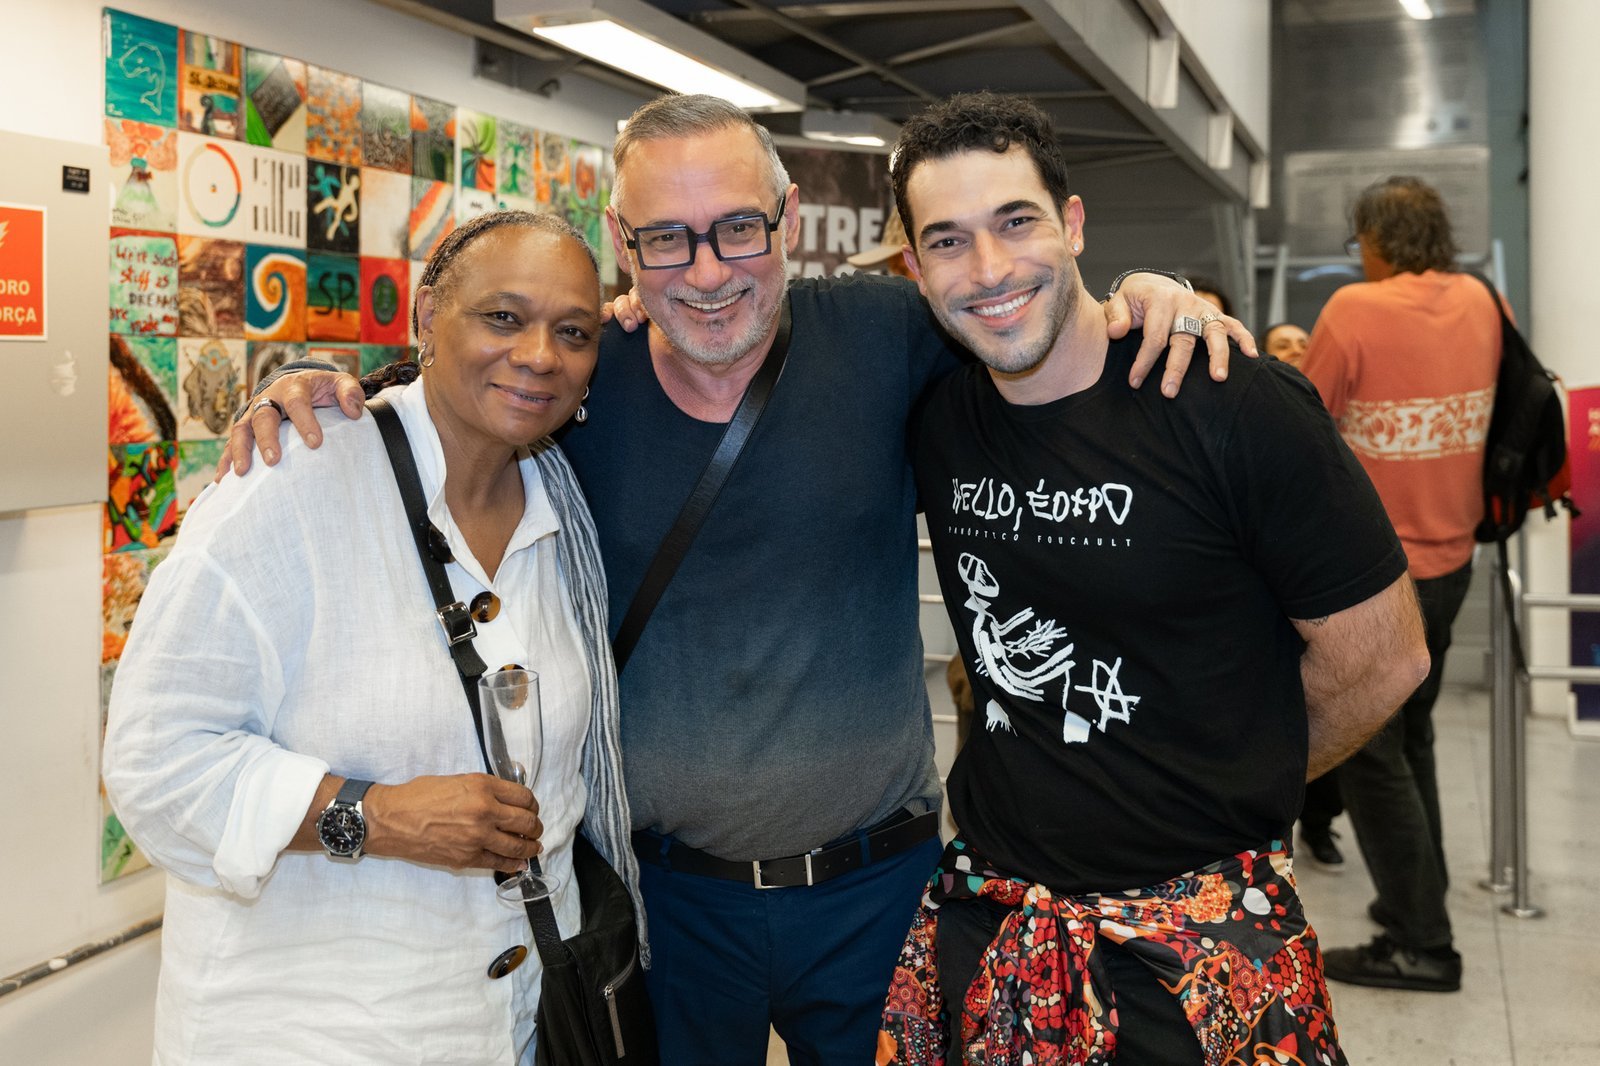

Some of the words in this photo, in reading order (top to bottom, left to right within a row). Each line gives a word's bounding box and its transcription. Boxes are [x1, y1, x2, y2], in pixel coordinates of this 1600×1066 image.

[315, 271, 355, 319] SP
[0, 305, 38, 326] RÇA
[1037, 535, 1131, 547] FOUCAULT
